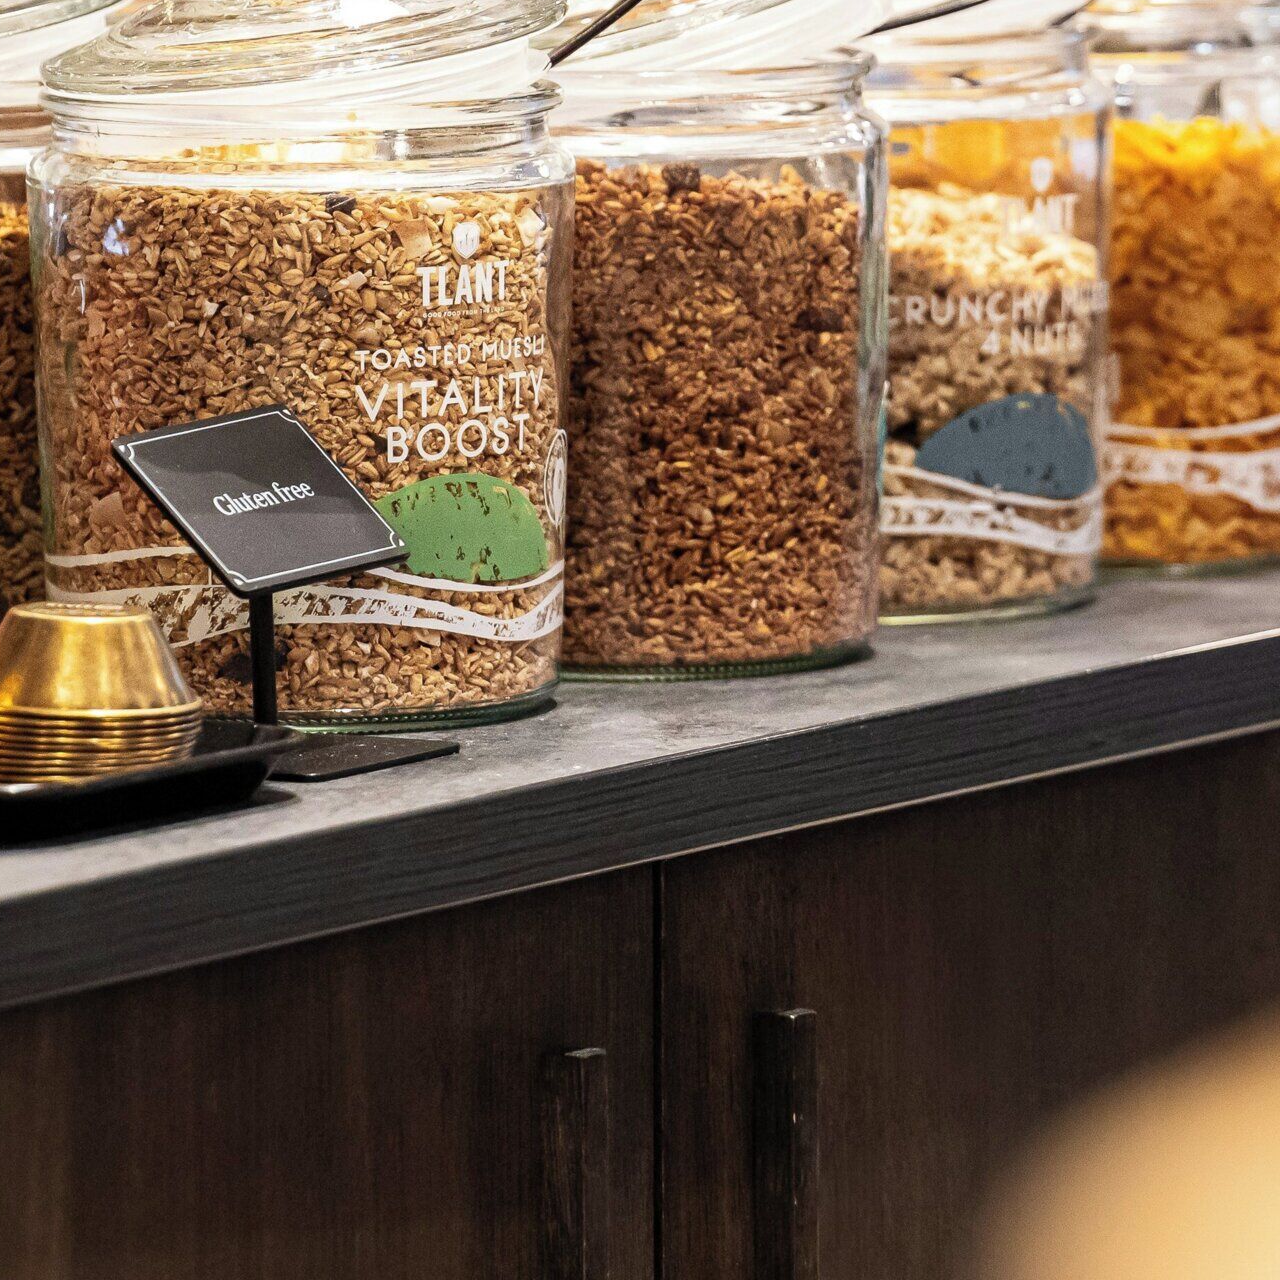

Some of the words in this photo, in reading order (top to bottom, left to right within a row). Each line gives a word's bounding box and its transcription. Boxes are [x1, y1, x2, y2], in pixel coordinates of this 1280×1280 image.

[416, 259, 510, 308] TLANT
[355, 343, 471, 371] TOASTED
[482, 334, 545, 362] MUESLI
[355, 367, 544, 423] VITALITY
[386, 413, 530, 464] BOOST
[212, 491, 281, 516] Gluten
[271, 481, 315, 503] free
